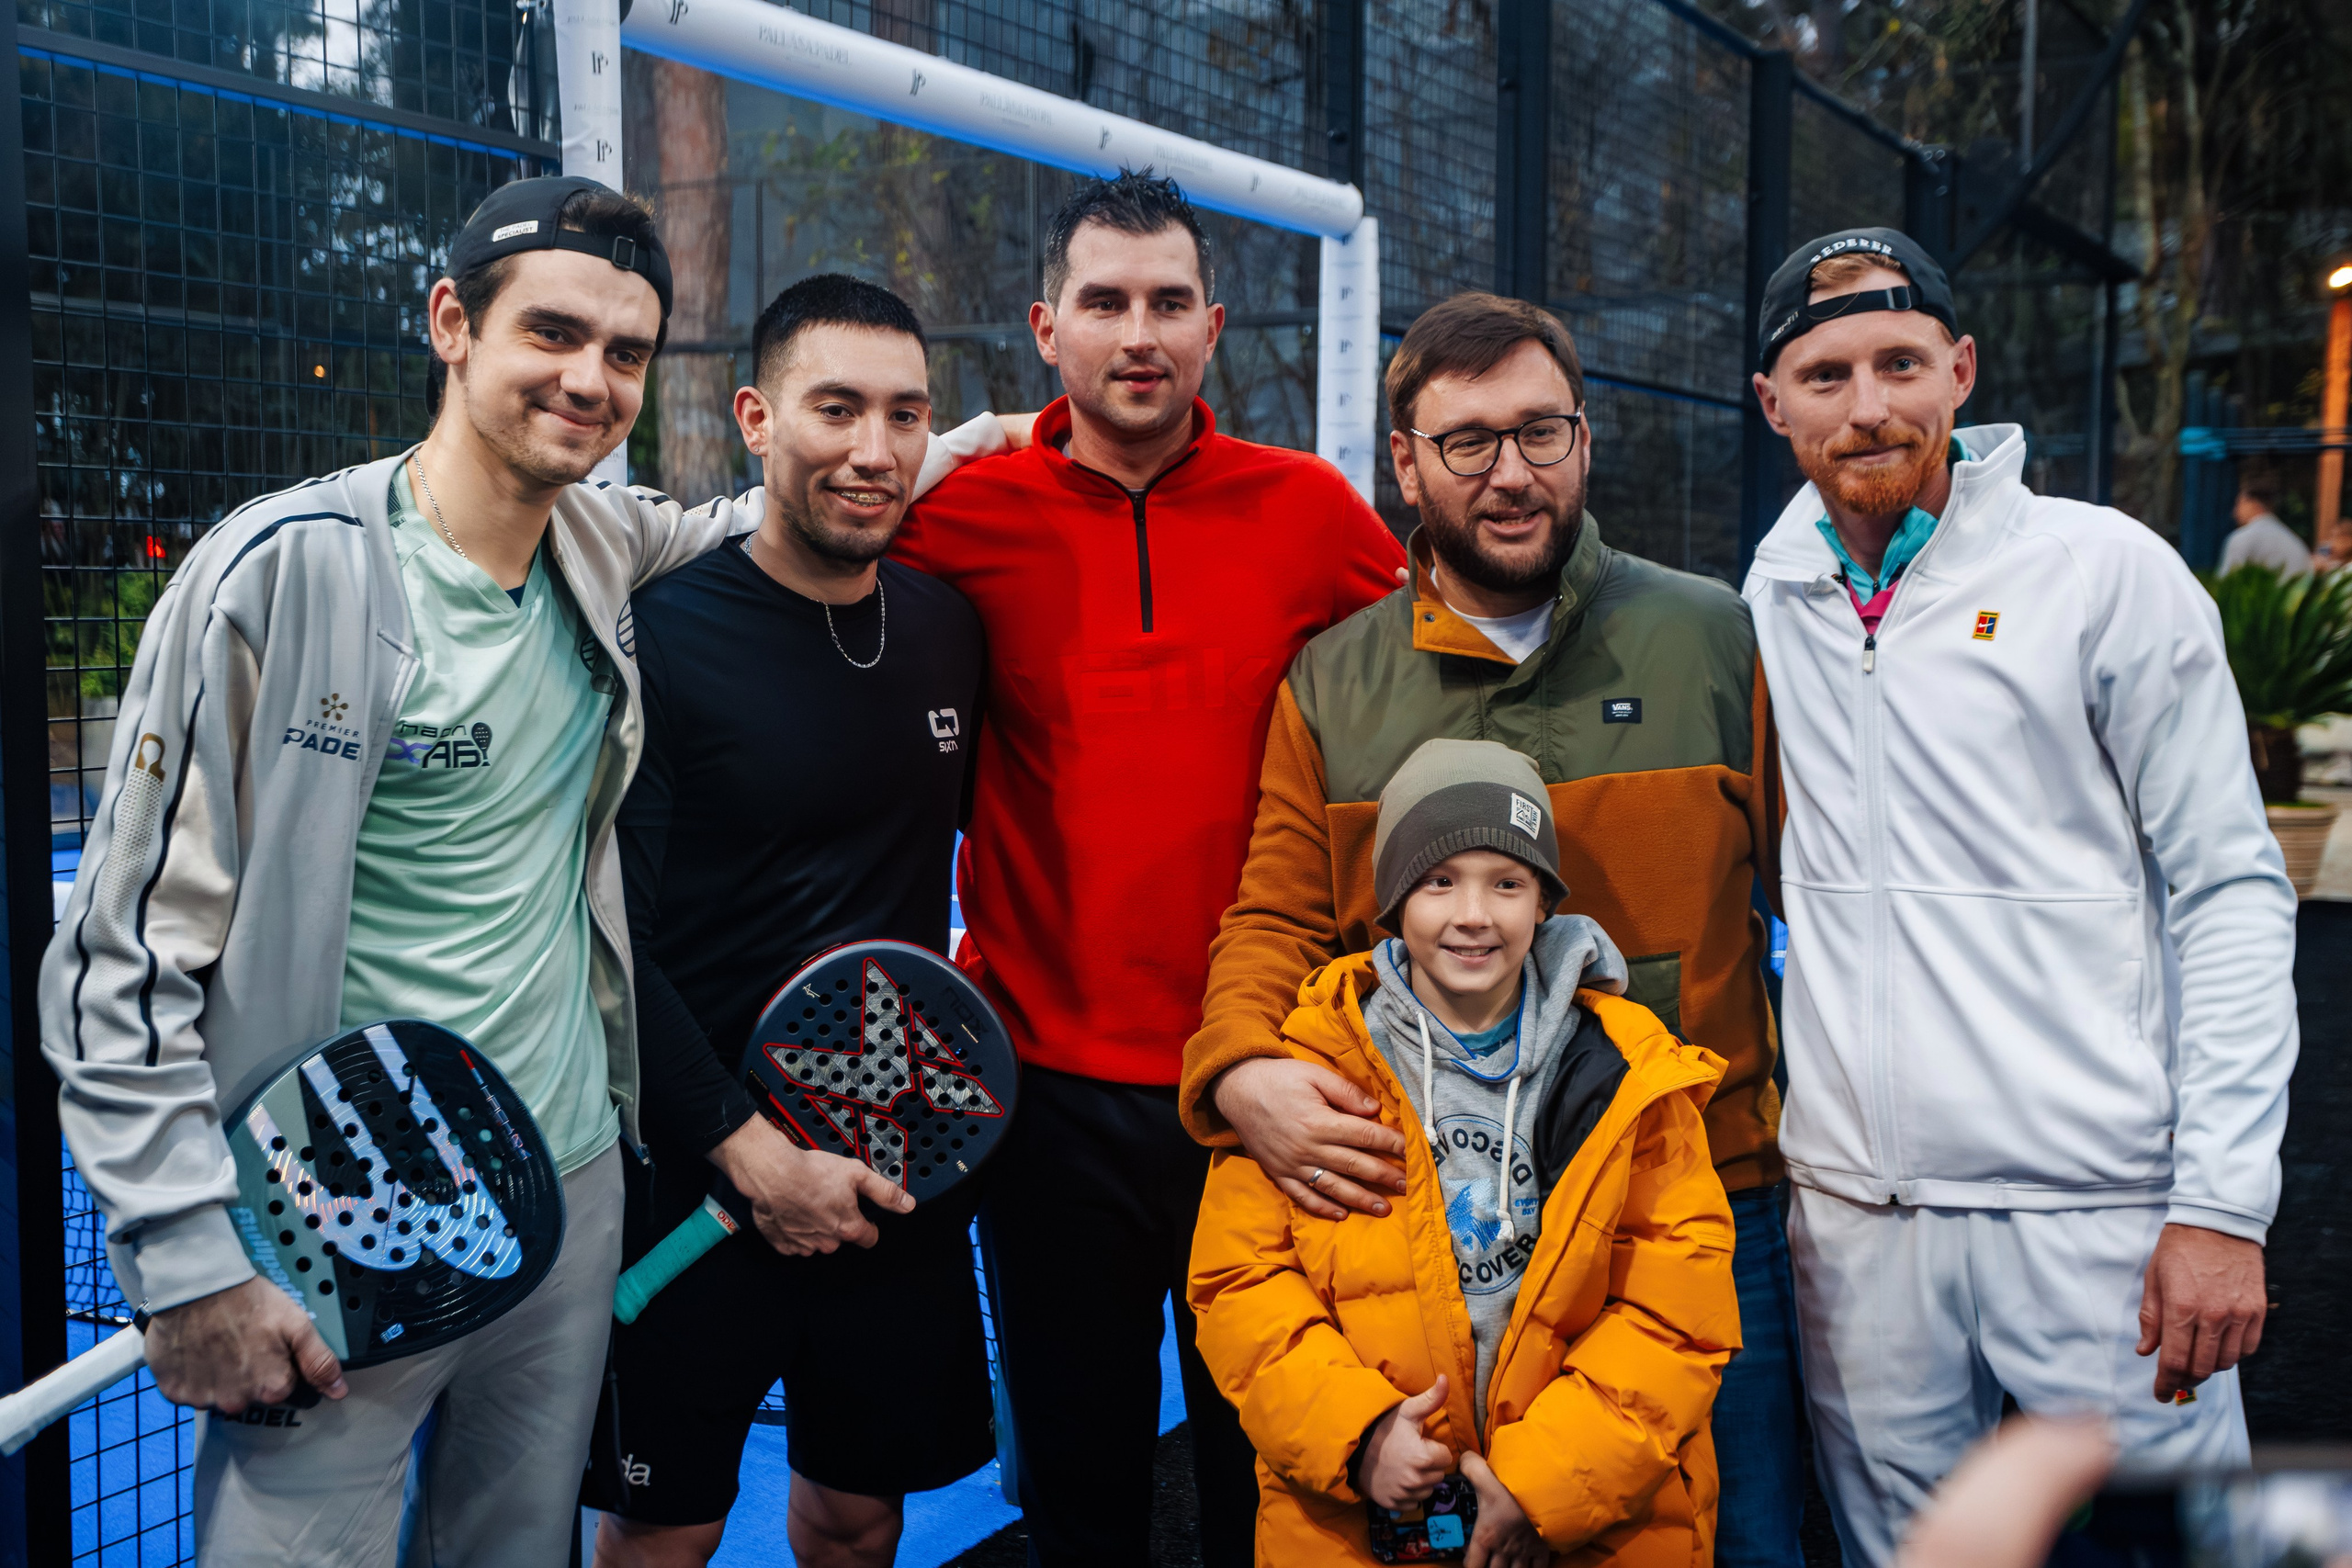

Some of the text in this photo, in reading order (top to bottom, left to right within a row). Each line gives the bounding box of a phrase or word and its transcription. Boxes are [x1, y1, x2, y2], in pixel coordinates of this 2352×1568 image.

[497, 226, 534, 239] SPECIALIST
[1611, 702, 1633, 711] VANS
[282, 728, 361, 761] PADE
[306, 719, 359, 738] PREMIER
[1431, 1128, 1533, 1186] DISCOVE
[231, 1207, 317, 1320] Bullpad
[1457, 1234, 1537, 1284] COVER
